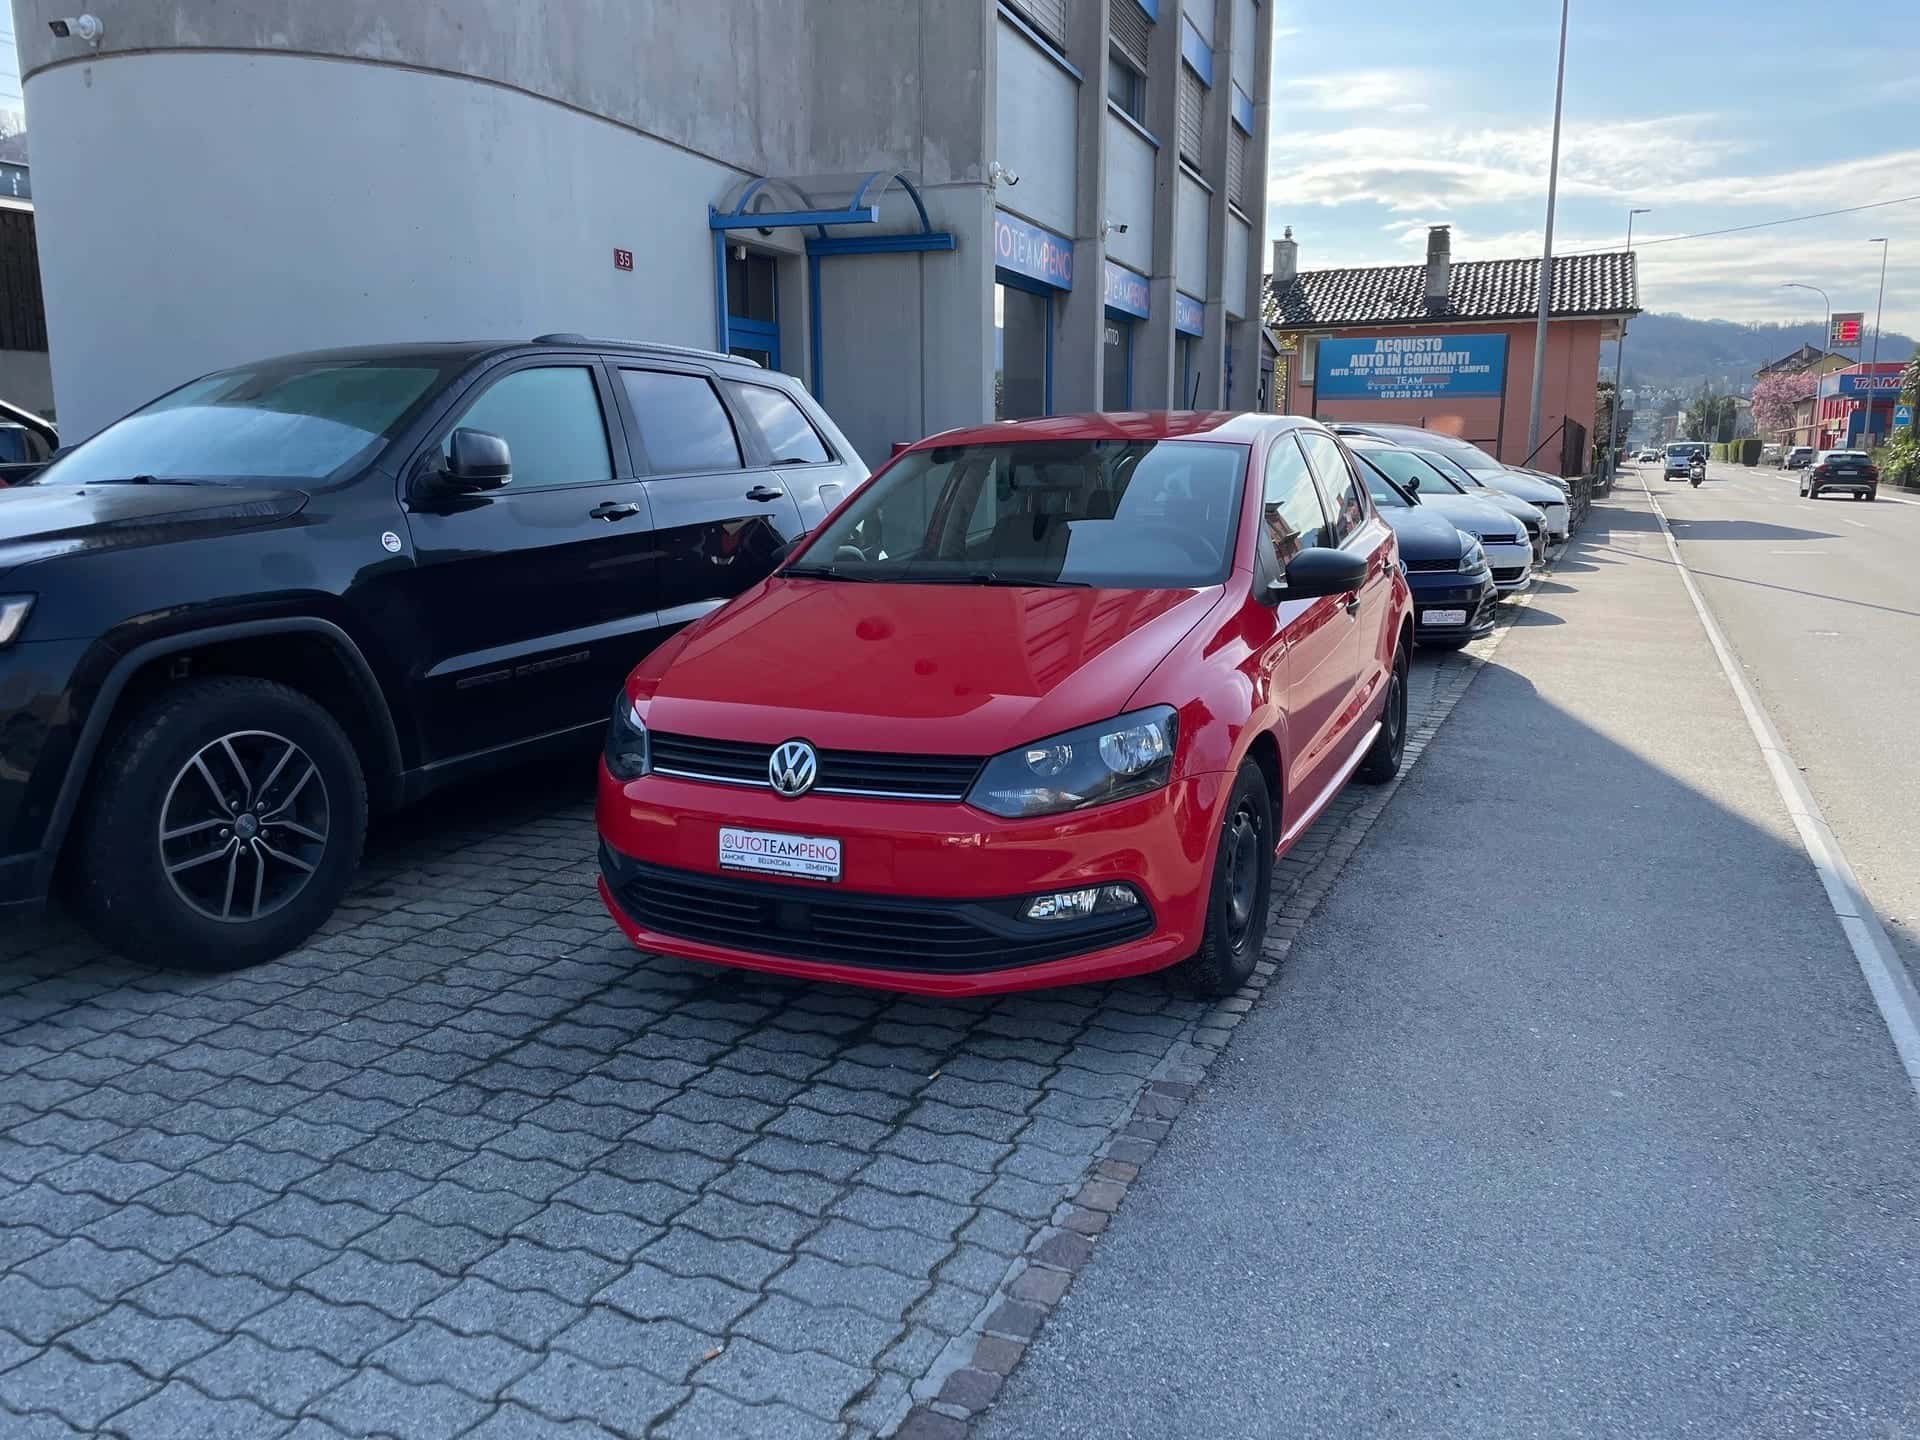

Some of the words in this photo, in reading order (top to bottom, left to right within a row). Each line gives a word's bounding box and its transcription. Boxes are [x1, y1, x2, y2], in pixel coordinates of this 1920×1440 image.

[619, 251, 630, 266] 35
[1375, 338, 1442, 353] ACQUISTO
[1350, 354, 1384, 367] AUTO
[1387, 353, 1401, 366] IN
[1404, 352, 1470, 365] CONTANTI
[1330, 368, 1349, 376] AUTO
[1854, 377, 1906, 390] TAM
